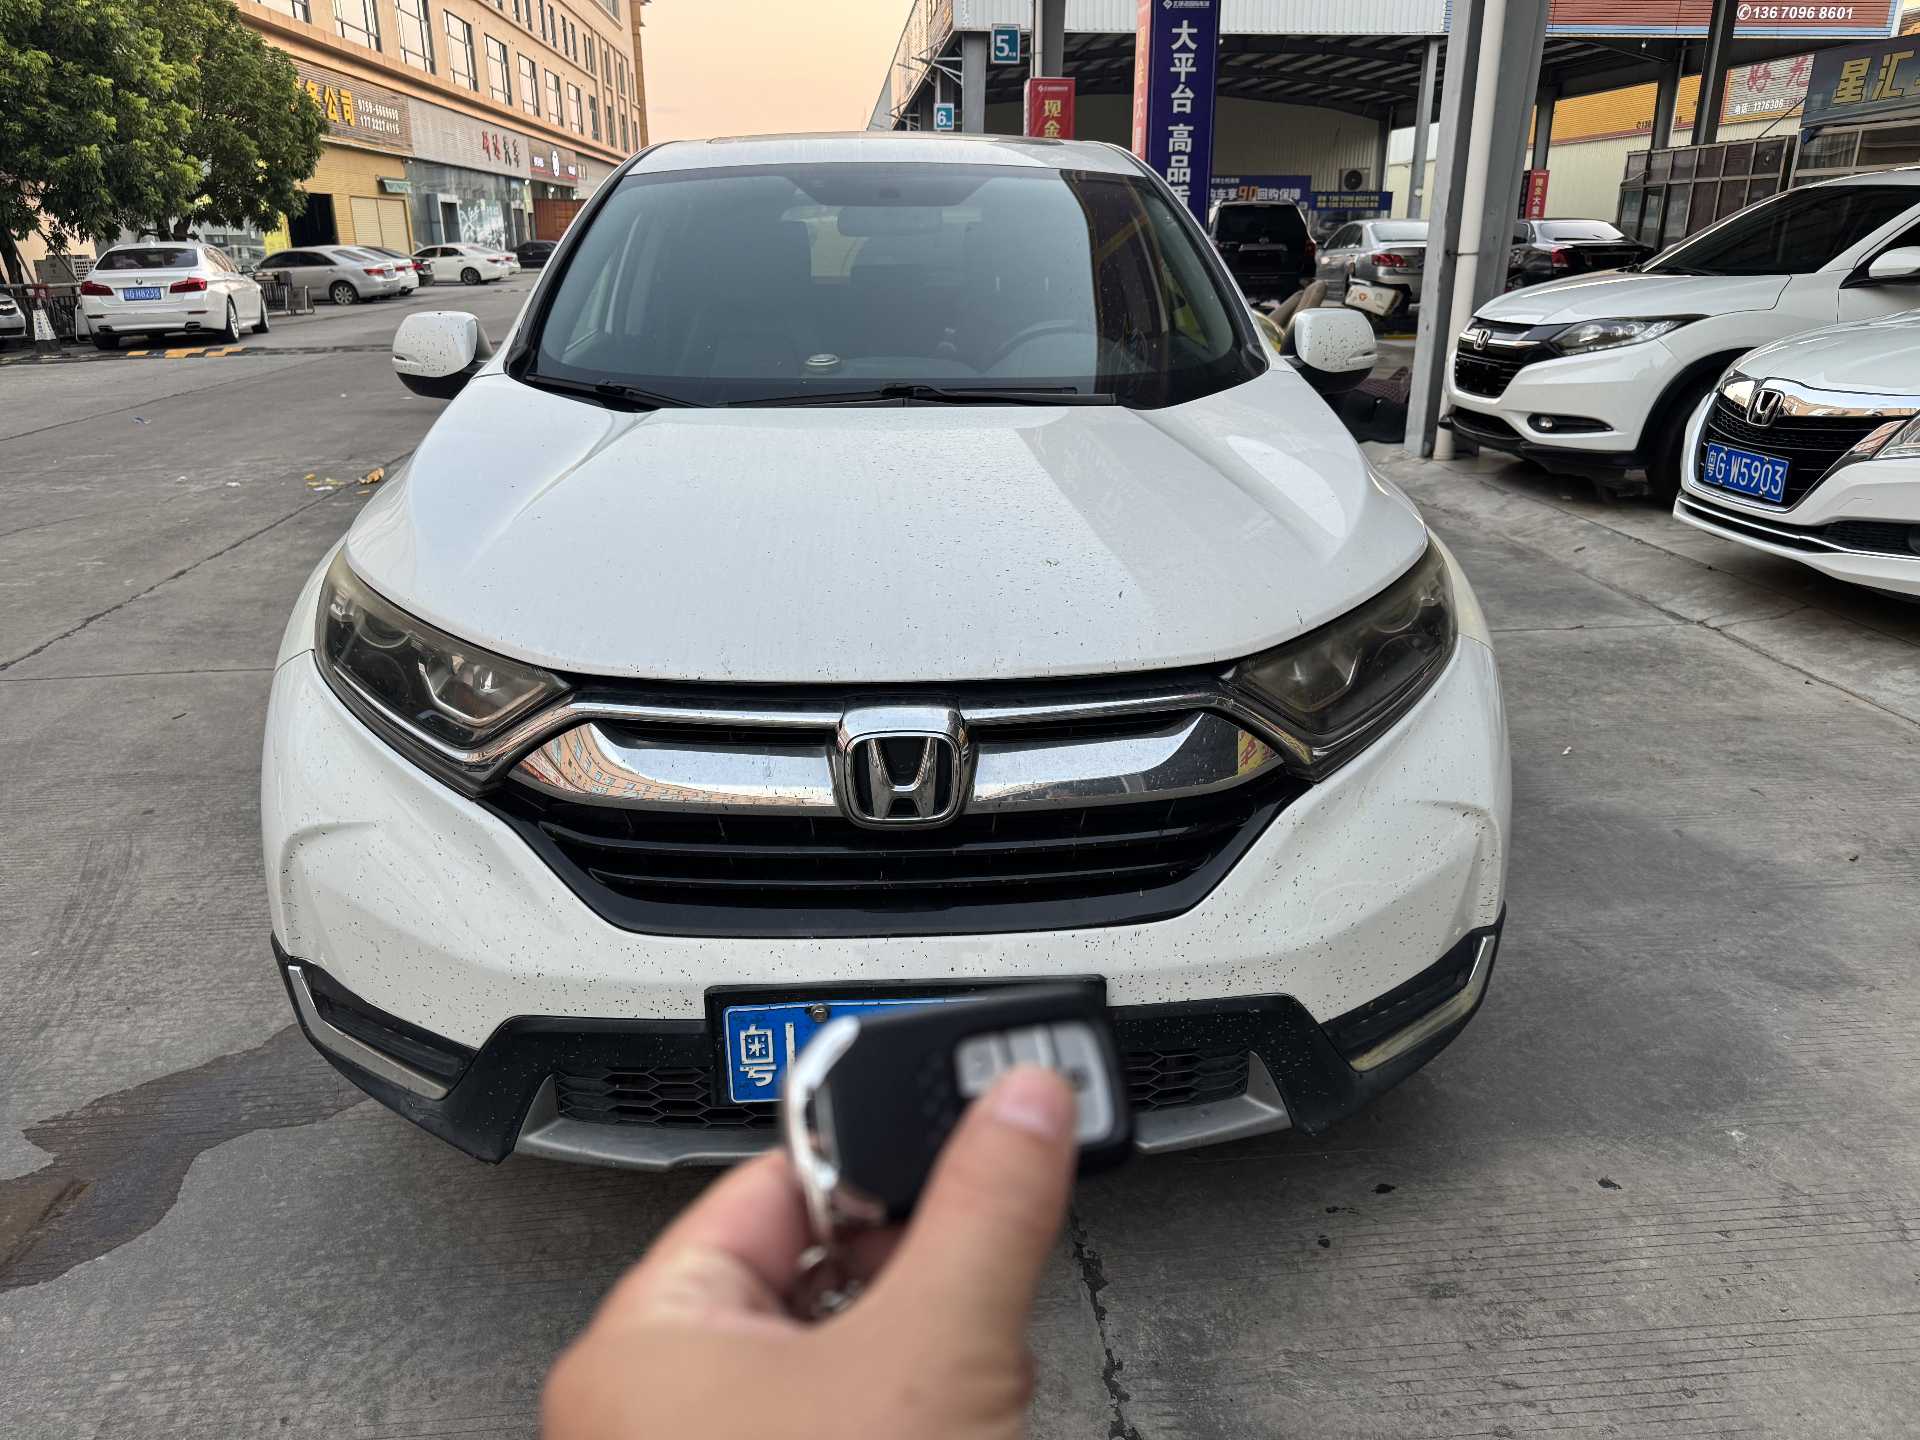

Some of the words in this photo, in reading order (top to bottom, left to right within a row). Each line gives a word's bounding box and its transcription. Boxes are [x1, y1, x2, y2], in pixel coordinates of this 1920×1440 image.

[1752, 7, 1778, 19] 136
[1781, 7, 1815, 19] 7096
[1818, 6, 1854, 20] 8601
[995, 35, 1010, 57] 5
[1169, 19, 1198, 114] 大平台
[1831, 50, 1920, 105] 星汇
[936, 110, 946, 126] 6
